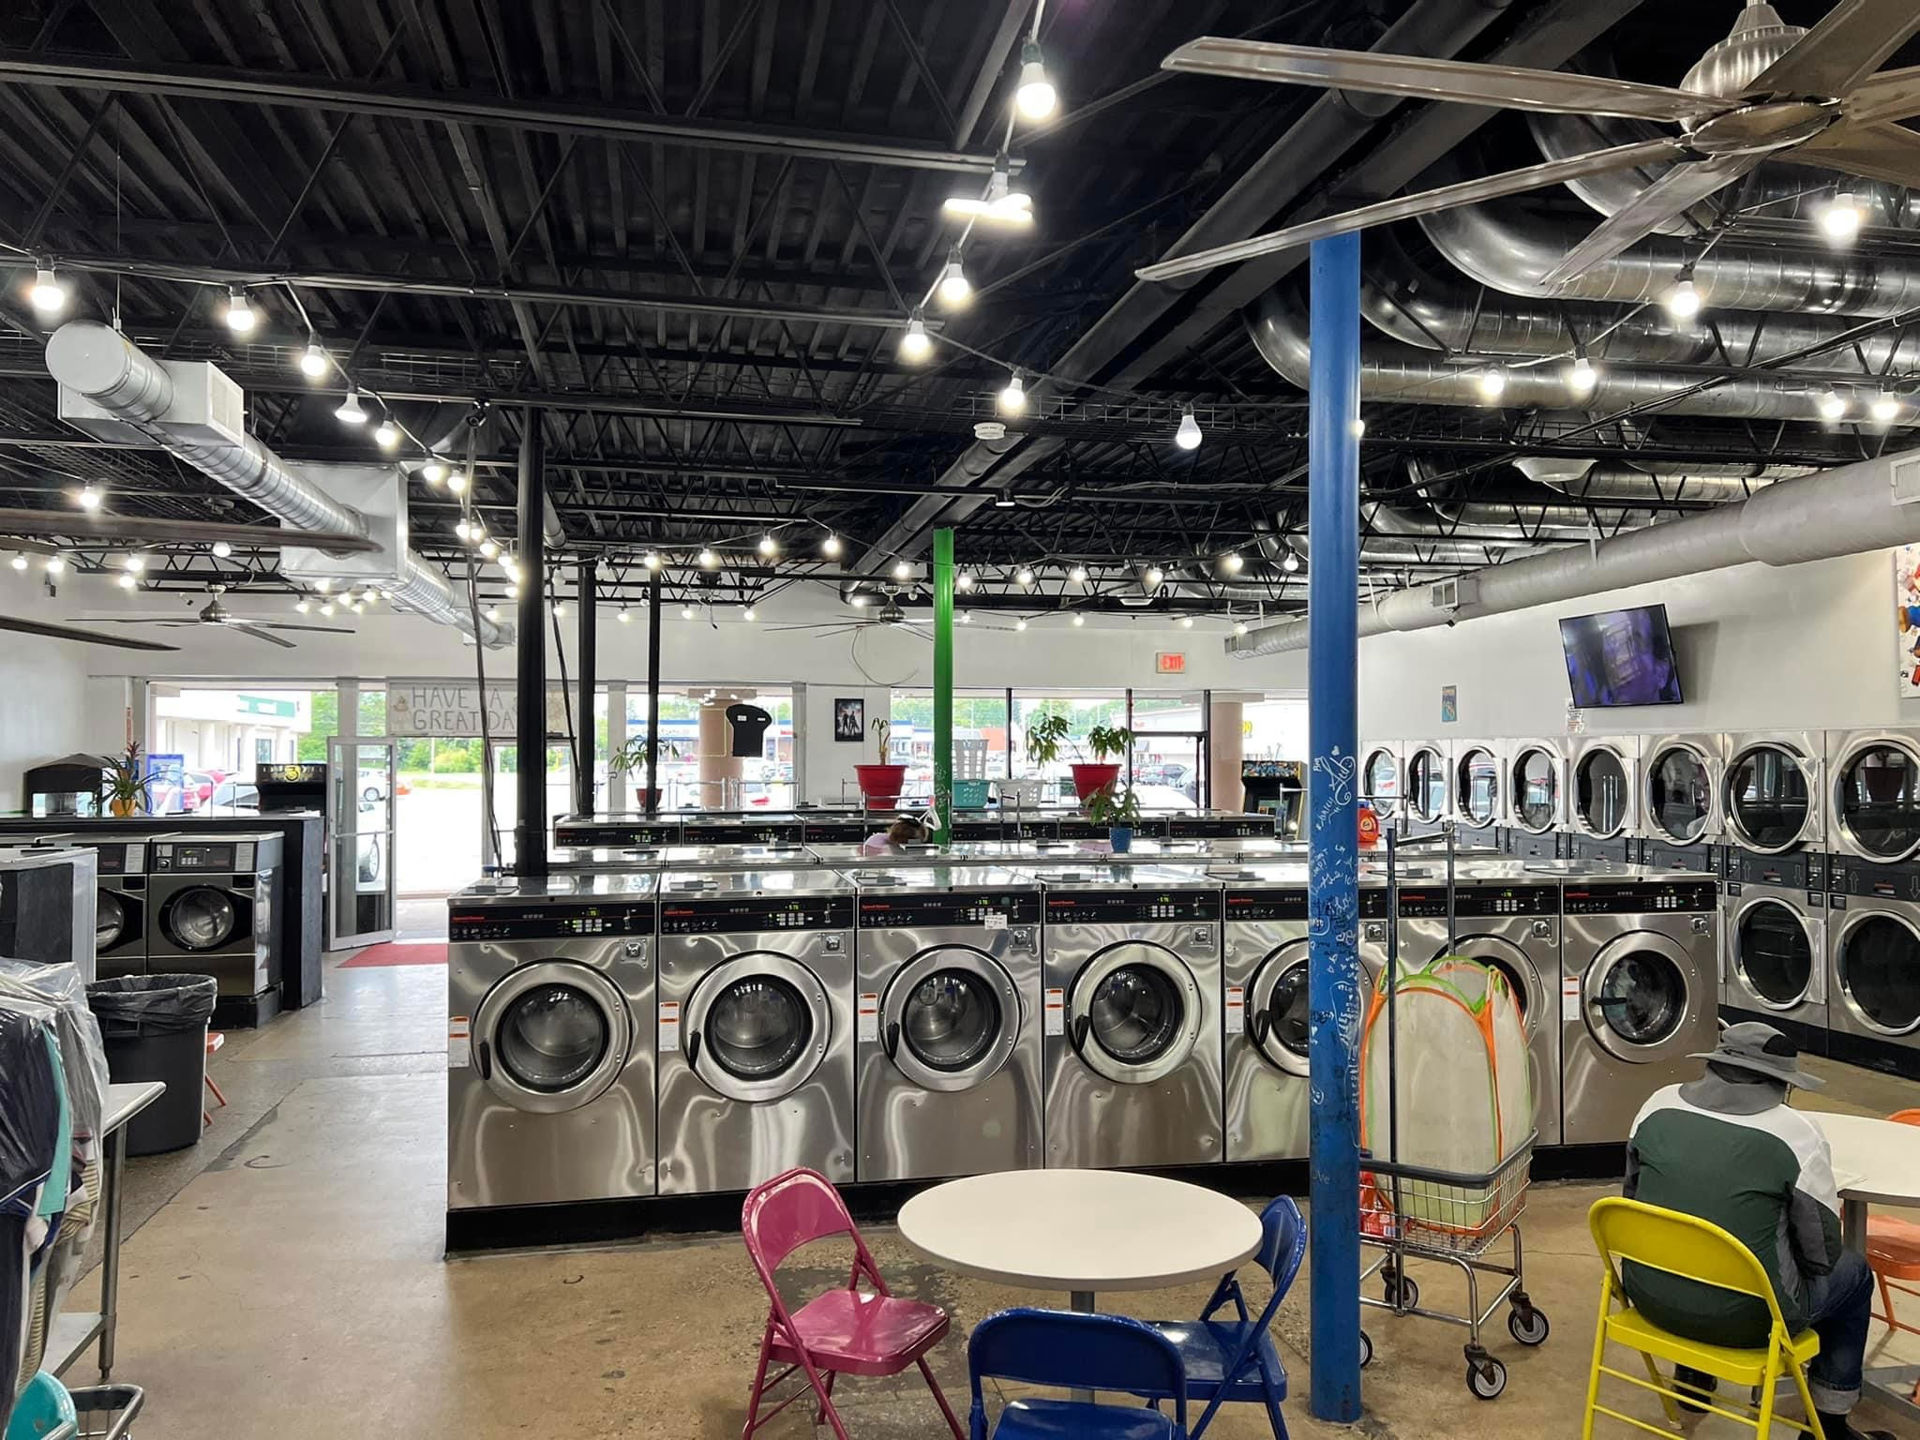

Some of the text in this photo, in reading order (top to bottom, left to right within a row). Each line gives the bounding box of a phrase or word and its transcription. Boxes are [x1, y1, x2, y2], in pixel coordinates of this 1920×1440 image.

[1161, 655, 1184, 670] EXIT
[412, 687, 505, 710] HAVE A
[413, 709, 516, 731] GREAT DA
